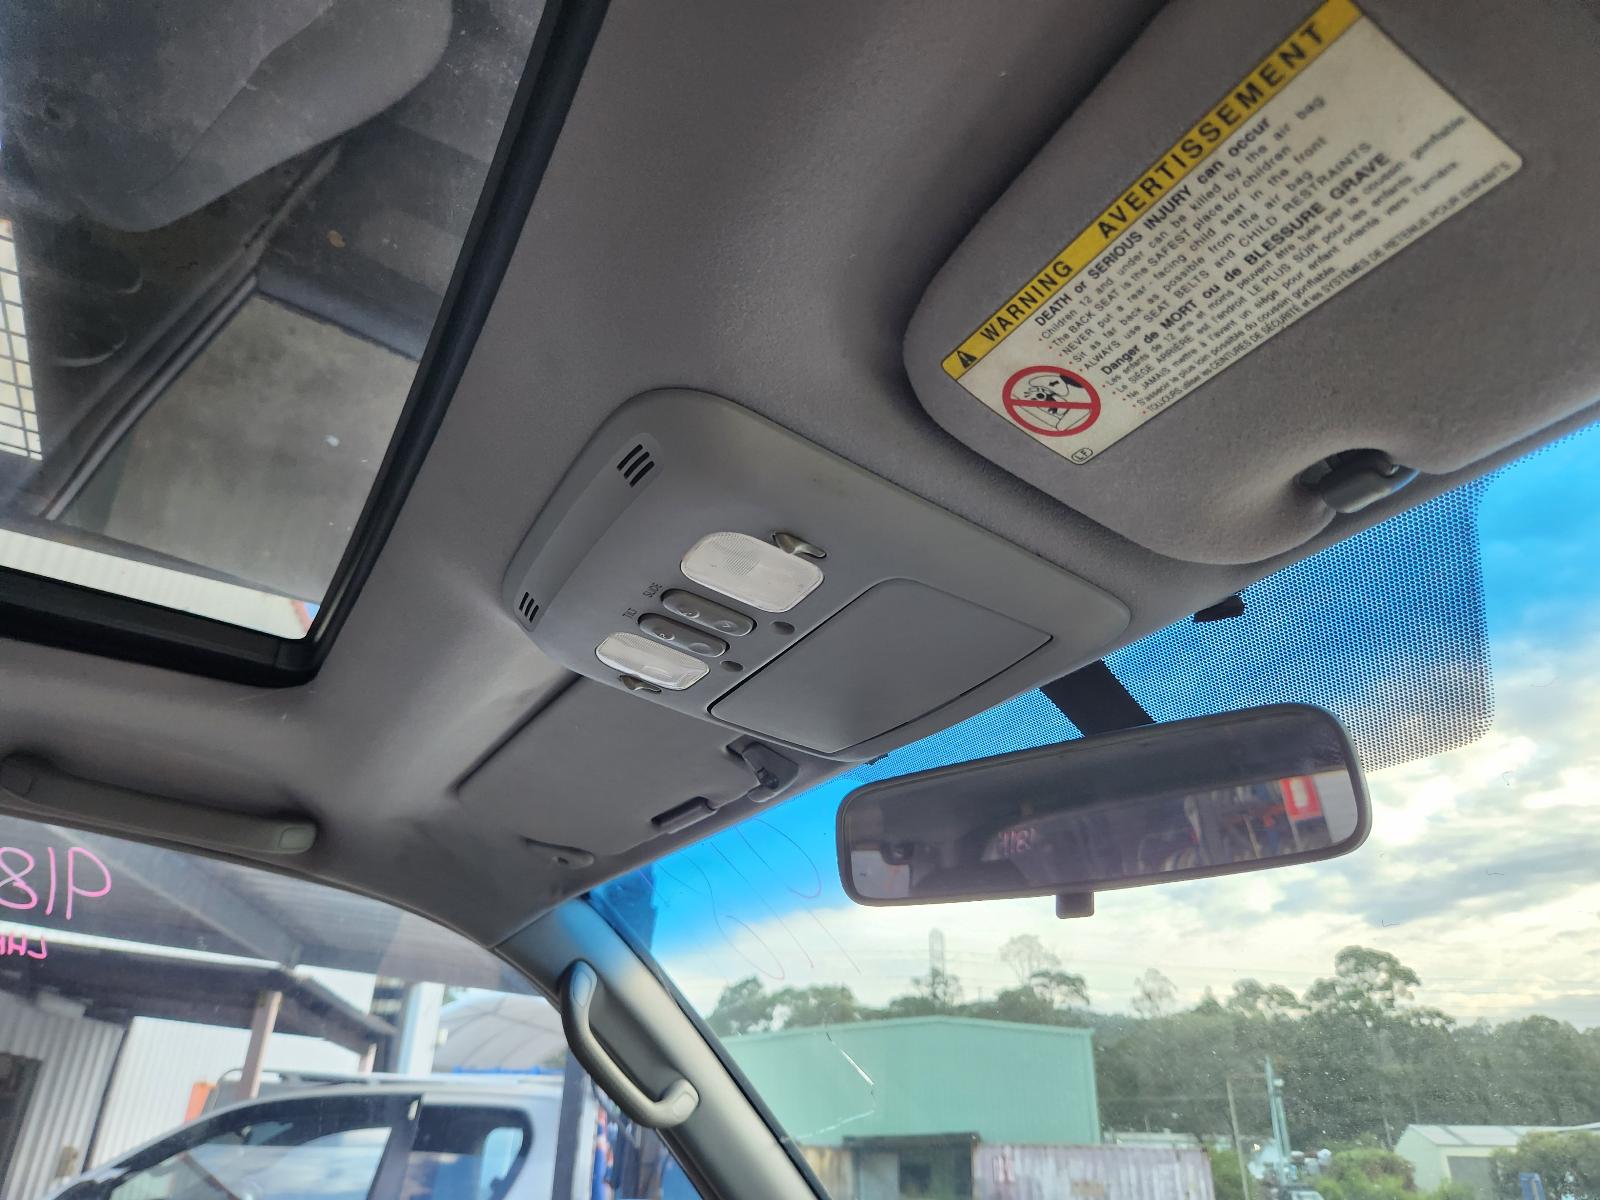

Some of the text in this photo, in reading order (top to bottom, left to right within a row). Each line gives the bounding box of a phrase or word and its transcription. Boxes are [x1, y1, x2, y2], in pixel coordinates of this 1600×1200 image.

[979, 20, 1328, 343] WARNING AVERTISSEMENT
[1033, 116, 1273, 326] DEATH or SERIOUS INJURY can occur
[1039, 94, 1327, 340] Children 12 and under can be killed by the air bag
[1051, 143, 1293, 347] The BACK SEAT is the SAFEST place for children
[1061, 327, 1095, 355] NEVER
[1095, 312, 1115, 328] put
[1126, 285, 1148, 303] rear
[1151, 252, 1188, 281] facing
[1186, 227, 1217, 252] child
[1218, 202, 1247, 226] seat
[1248, 187, 1264, 201] in
[1265, 166, 1290, 187] the
[1292, 135, 1328, 165] front
[1071, 168, 1315, 363] Sit as far back as possible from the air bag
[1082, 140, 1373, 370] ALWAYS use SEAT BELTS and CHILD RESTRAINTS
[1099, 152, 1390, 376] Danger de MORT ou de BLESSURE GRAVE
[1105, 373, 1122, 385] Les
[1148, 342, 1163, 353] de
[1162, 332, 1176, 342] 12
[1176, 319, 1194, 333] ans
[1234, 259, 1274, 289] peuvent
[1115, 383, 1129, 393] Le
[1247, 283, 1263, 296] LE
[1260, 262, 1292, 286] PLUS
[1320, 223, 1347, 244] pour
[1138, 366, 1171, 390] JAMAIS
[1238, 309, 1252, 319] un
[1281, 271, 1306, 290] pour
[1176, 363, 1197, 378] plus
[1208, 329, 1246, 355] possible
[1241, 319, 1258, 331] du
